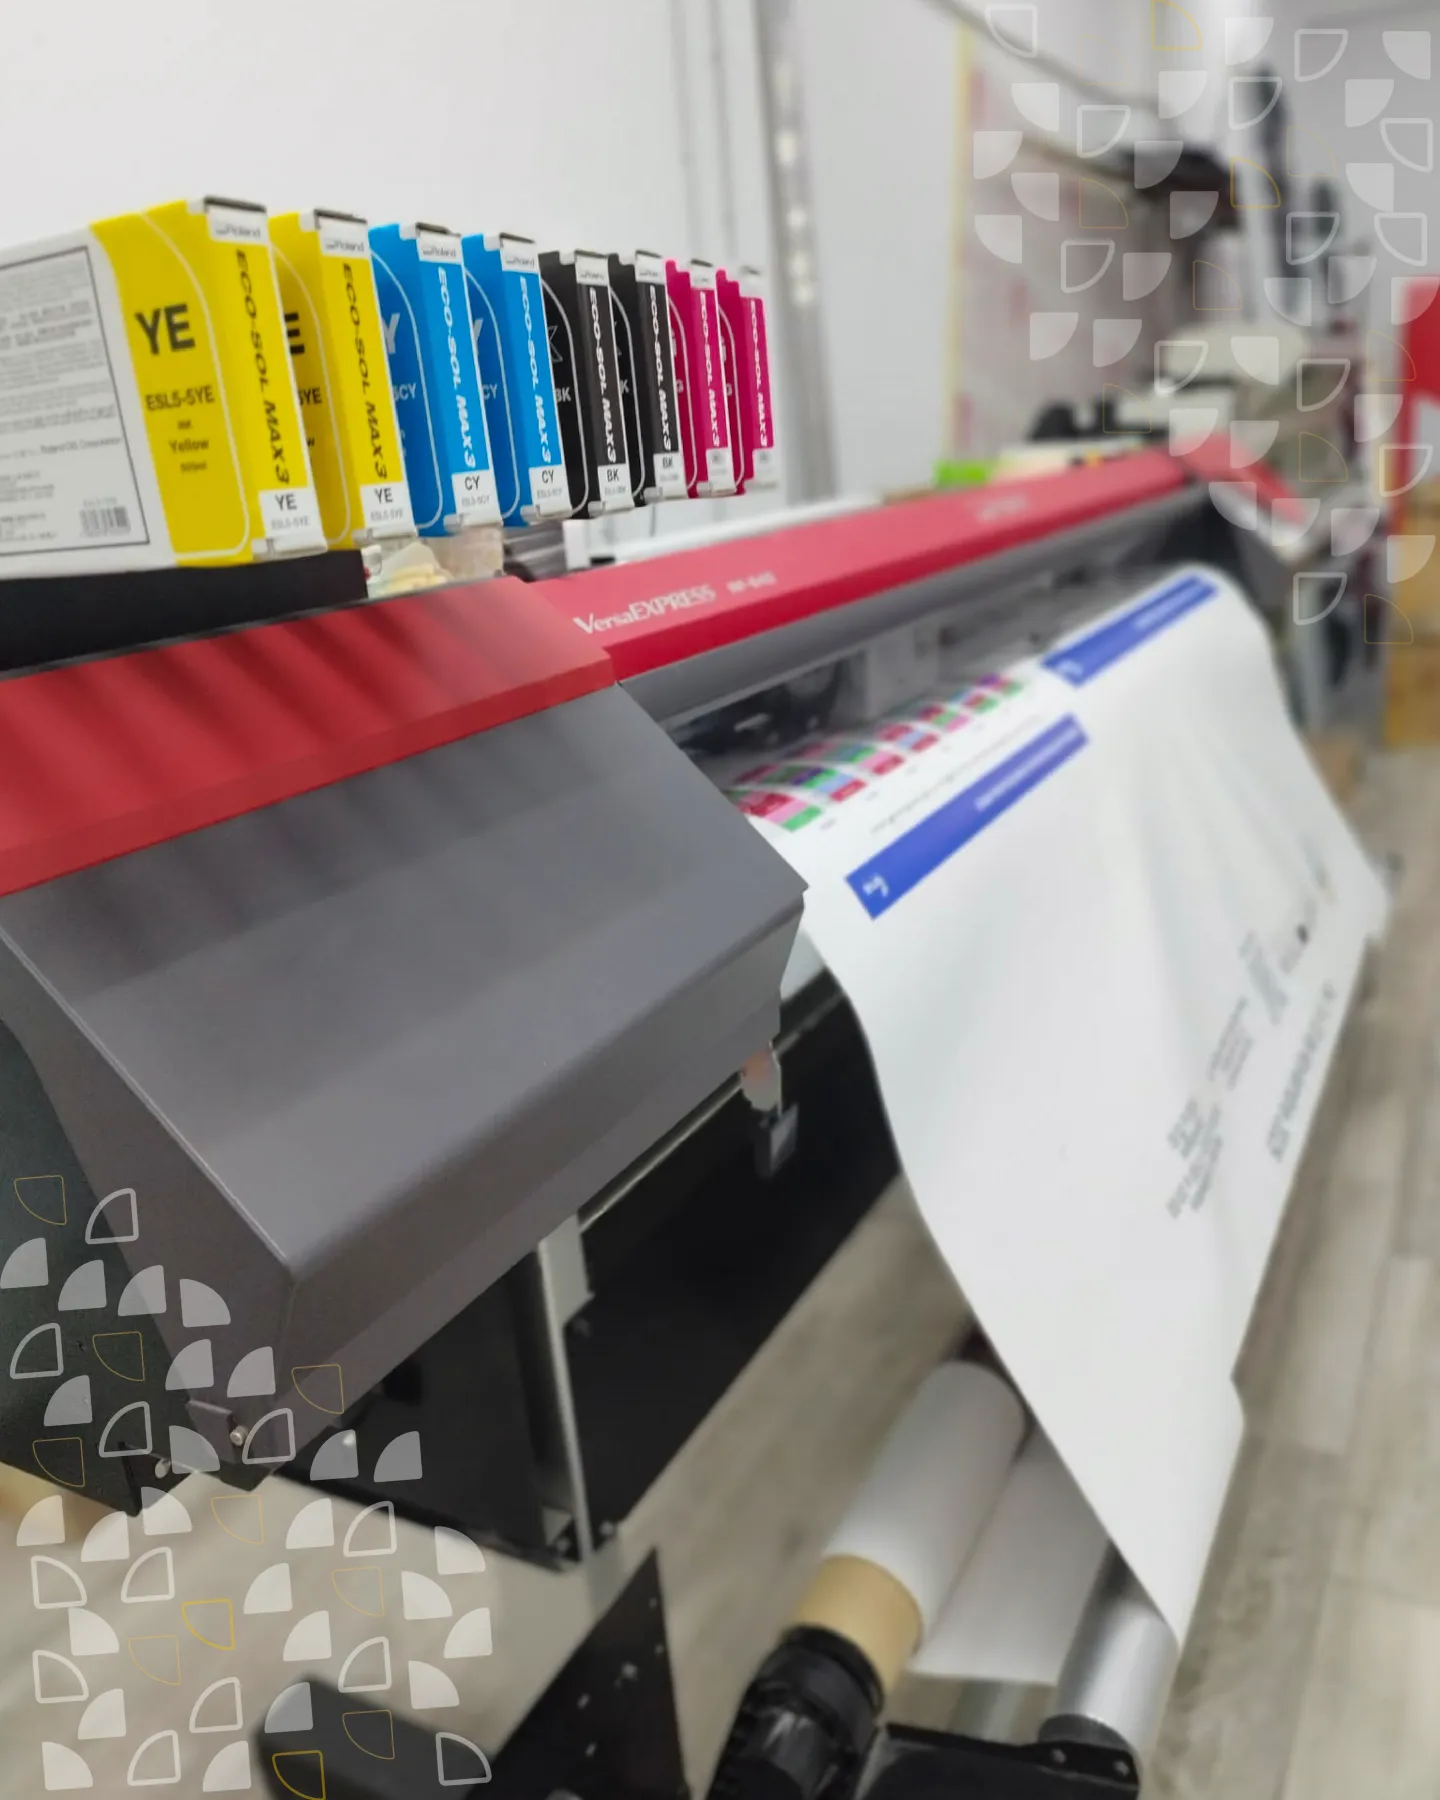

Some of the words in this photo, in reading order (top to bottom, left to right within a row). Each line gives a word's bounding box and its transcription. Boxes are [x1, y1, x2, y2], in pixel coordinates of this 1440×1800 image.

[236, 248, 270, 392] ECO-SOL
[343, 262, 371, 394] ECO-SOL
[437, 266, 461, 390] ECO-SOL
[134, 303, 196, 356] YE
[168, 438, 210, 454] Yellow
[464, 476, 480, 491] CY
[541, 470, 554, 484] CY
[607, 468, 619, 482] BK
[274, 493, 297, 511] YE
[374, 487, 393, 504] YE
[572, 583, 717, 634] VersaEXPRESS
